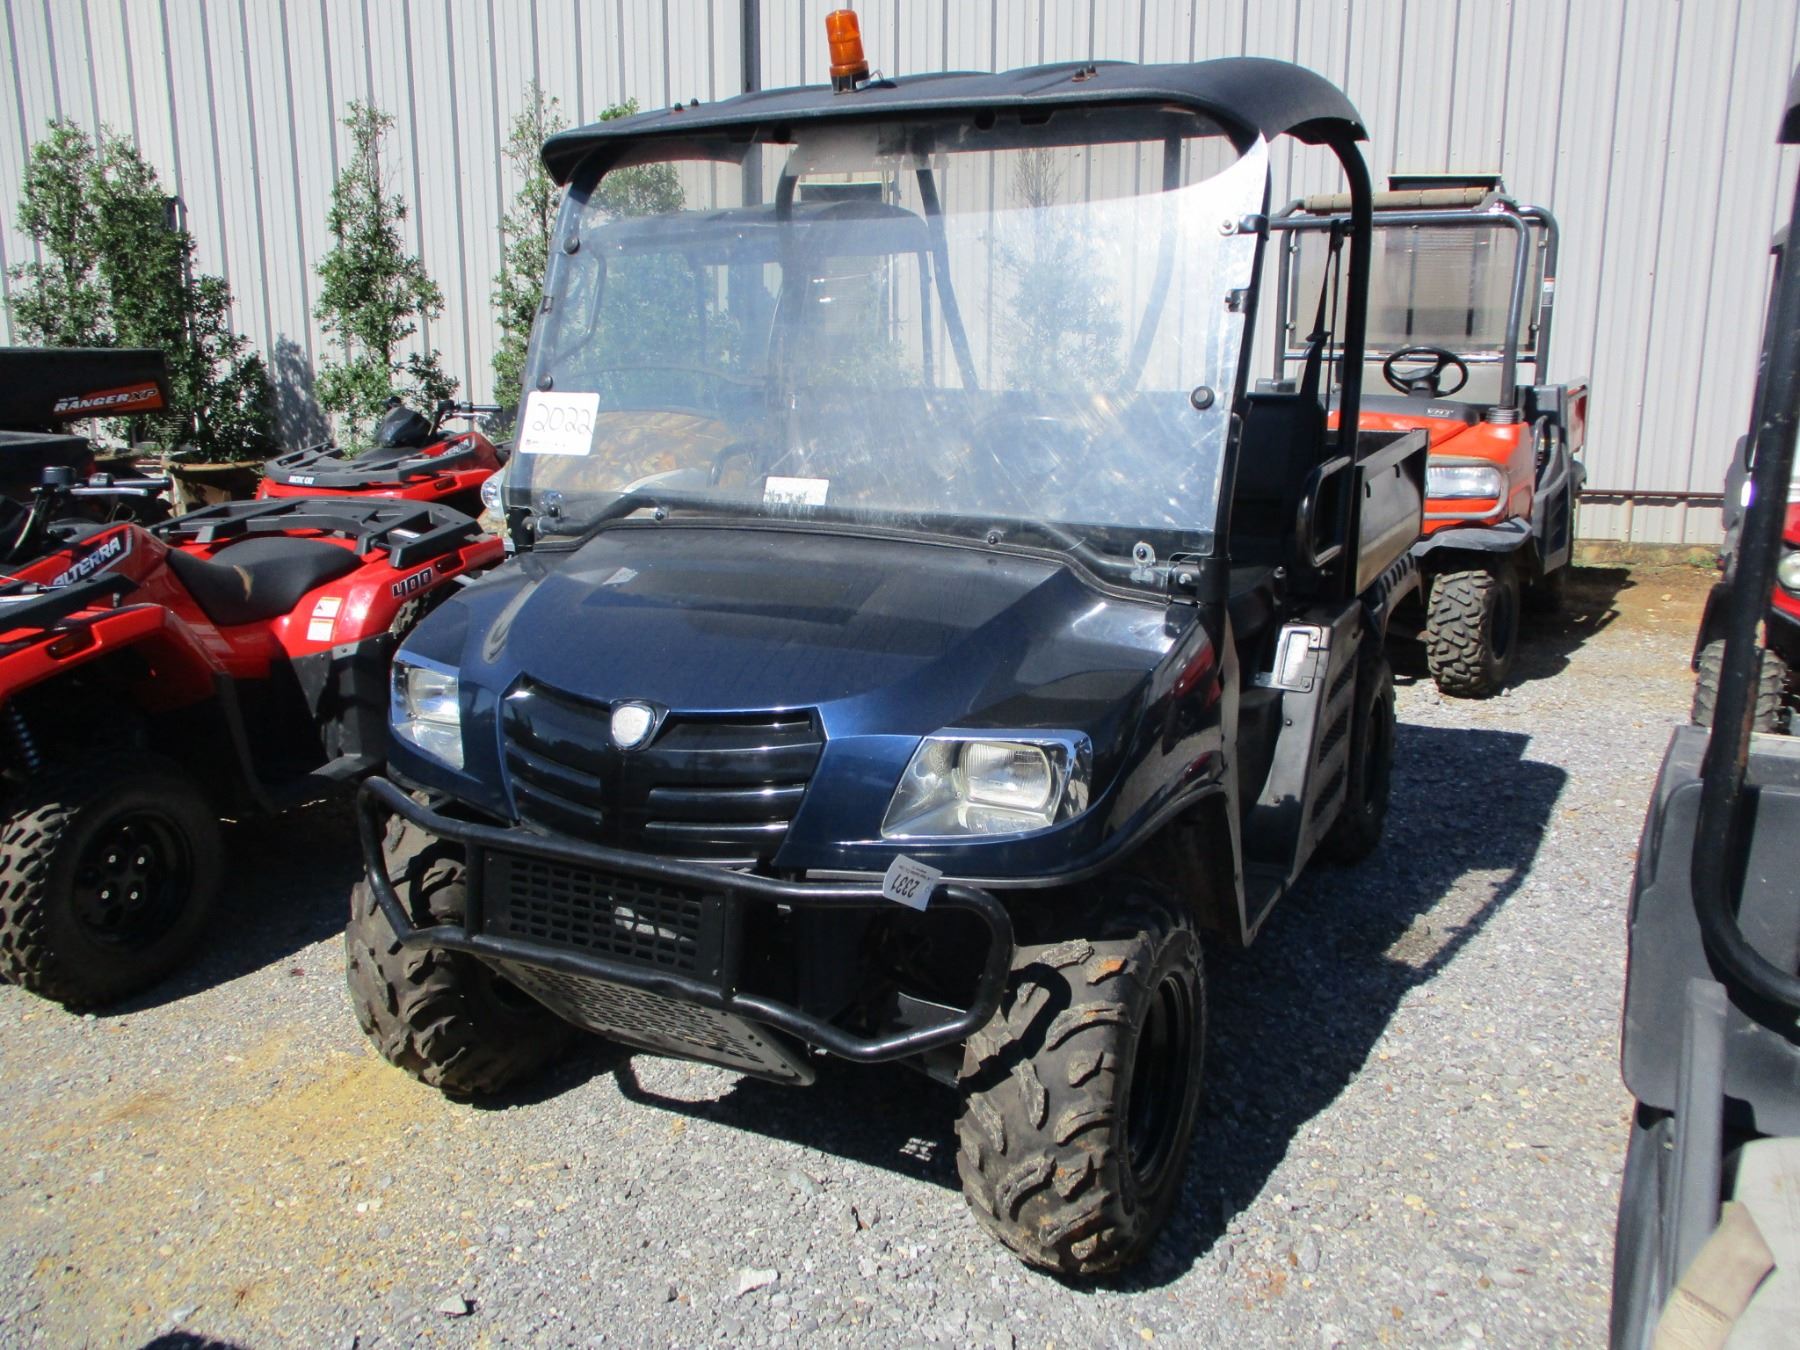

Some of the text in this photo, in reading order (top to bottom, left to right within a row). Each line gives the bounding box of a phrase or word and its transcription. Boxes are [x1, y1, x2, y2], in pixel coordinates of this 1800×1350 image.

[53, 394, 129, 412] RANGER
[532, 403, 592, 434] 2022
[53, 537, 120, 586] ALTERRA
[391, 567, 433, 599] 400
[890, 873, 920, 898] 2331
